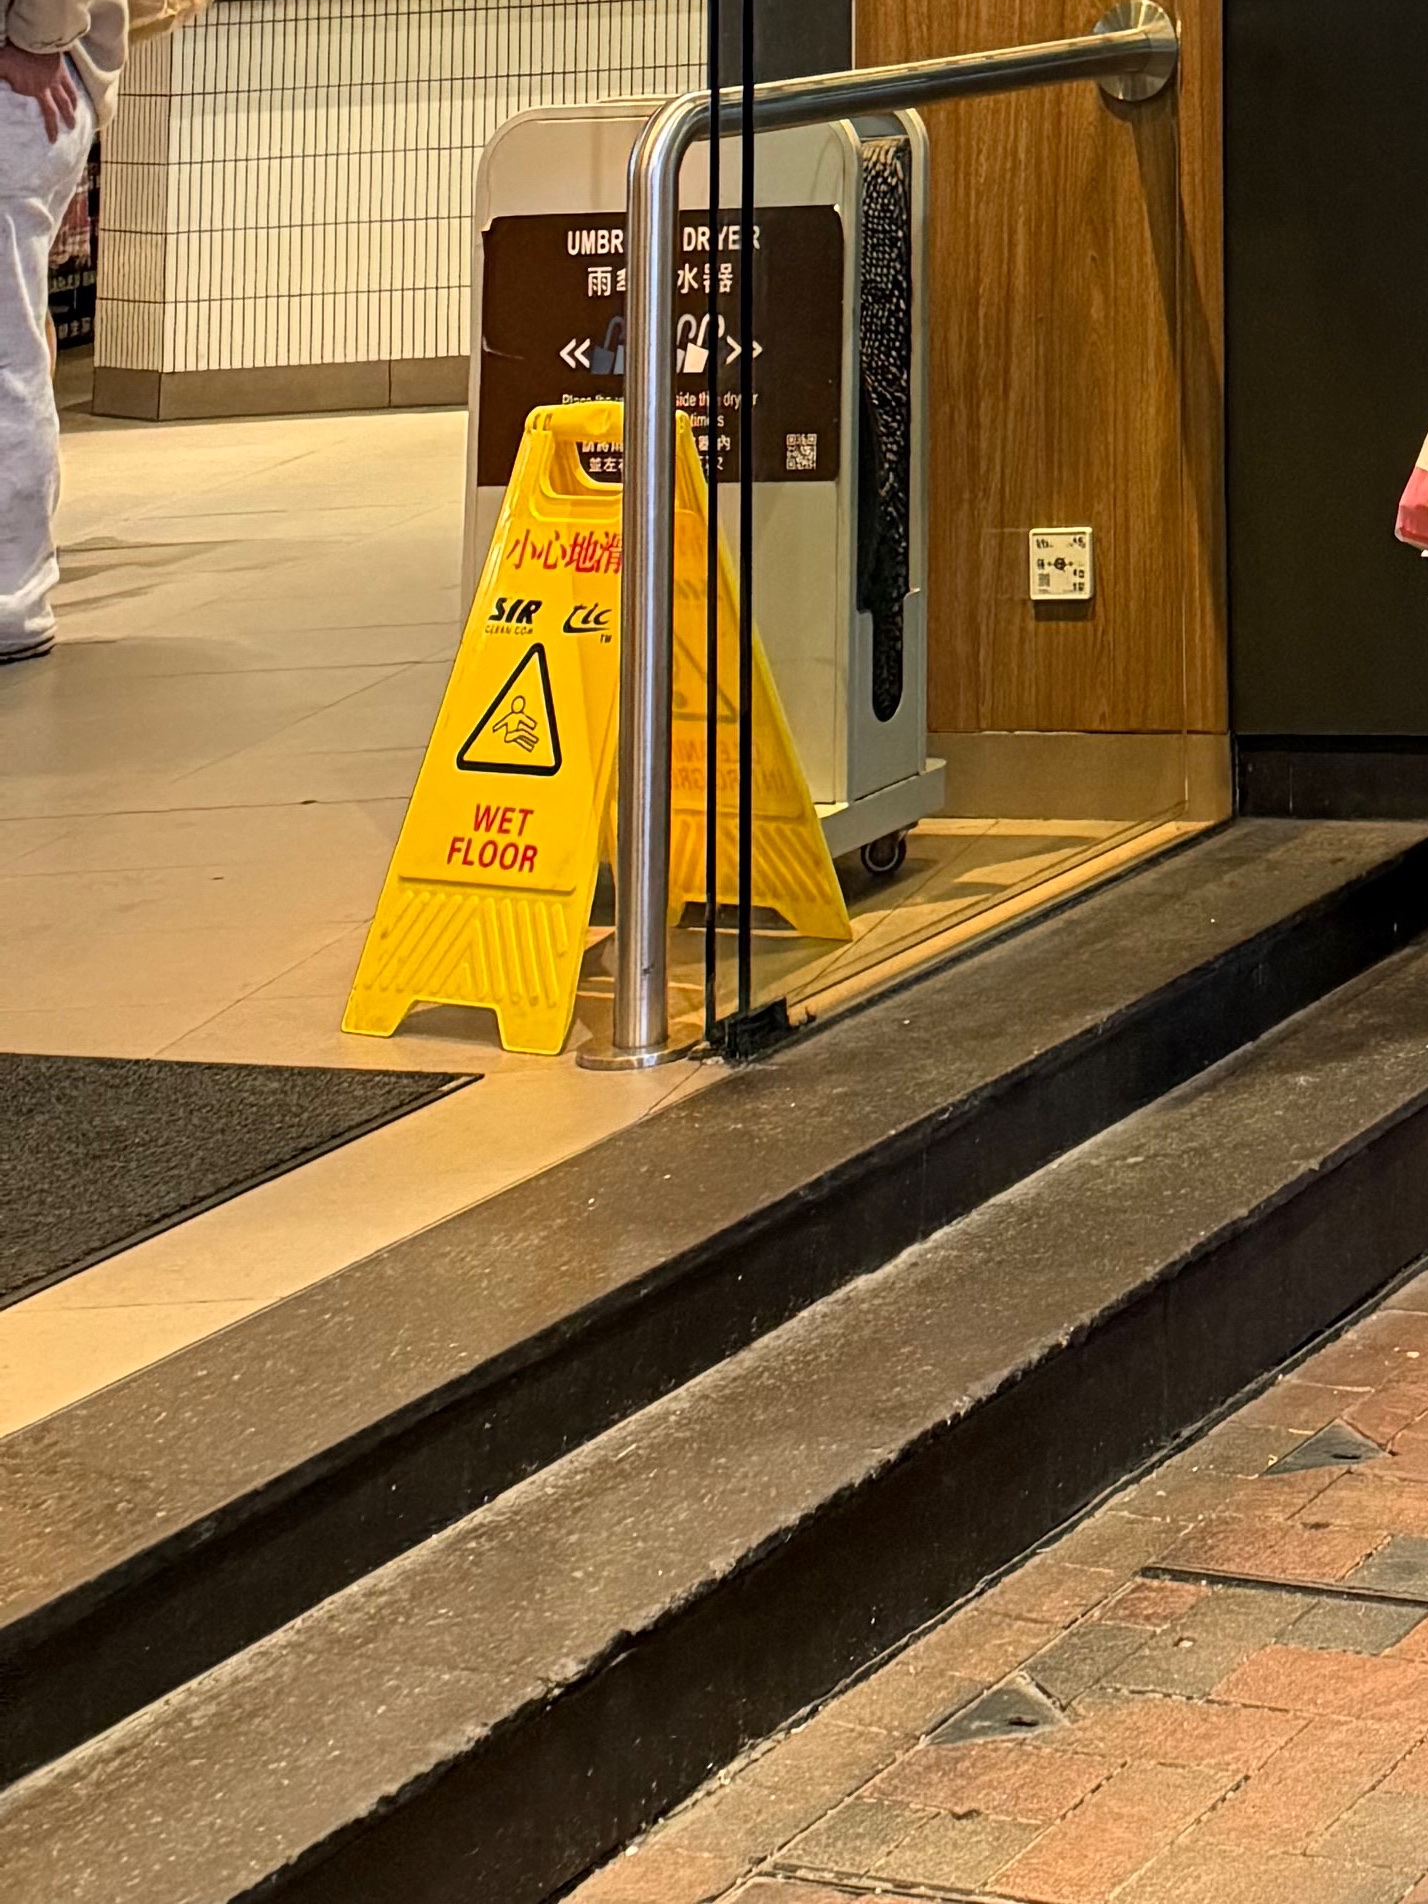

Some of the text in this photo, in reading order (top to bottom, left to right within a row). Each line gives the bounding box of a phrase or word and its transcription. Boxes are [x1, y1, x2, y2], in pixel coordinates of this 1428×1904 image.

[567, 229, 624, 256] UMBR
[723, 392, 758, 411] dryr
[690, 413, 724, 428] tims
[506, 529, 622, 575] 小心地滑
[488, 597, 543, 625] SIR
[472, 803, 534, 837] WET
[446, 836, 539, 874] FLOOR
